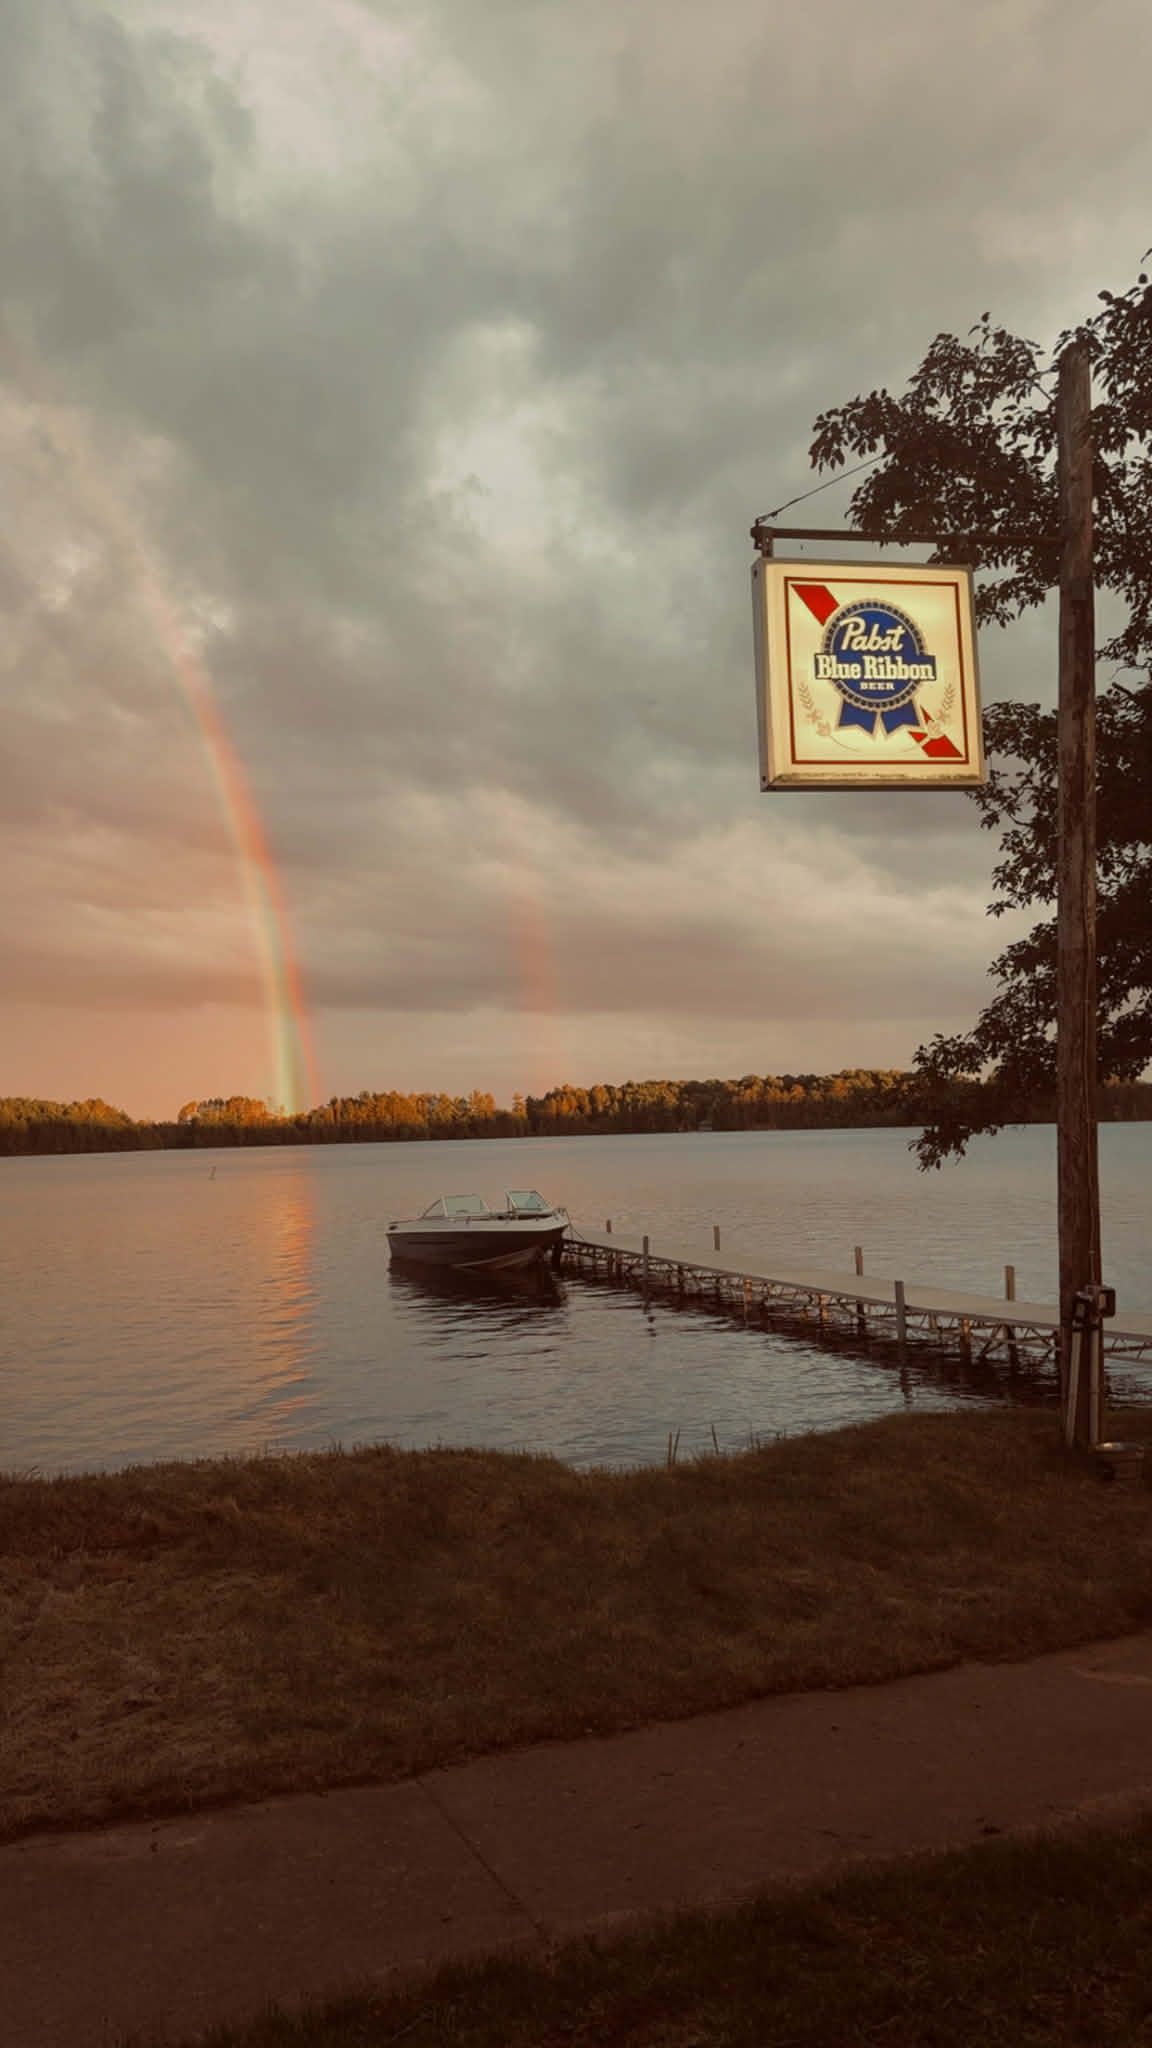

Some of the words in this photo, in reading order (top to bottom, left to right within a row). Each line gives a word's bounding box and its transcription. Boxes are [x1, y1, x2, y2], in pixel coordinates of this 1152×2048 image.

[839, 617, 905, 651] Pabst
[816, 655, 861, 679] Blue
[862, 655, 934, 680] Ribbon
[860, 682, 894, 690] BEER
